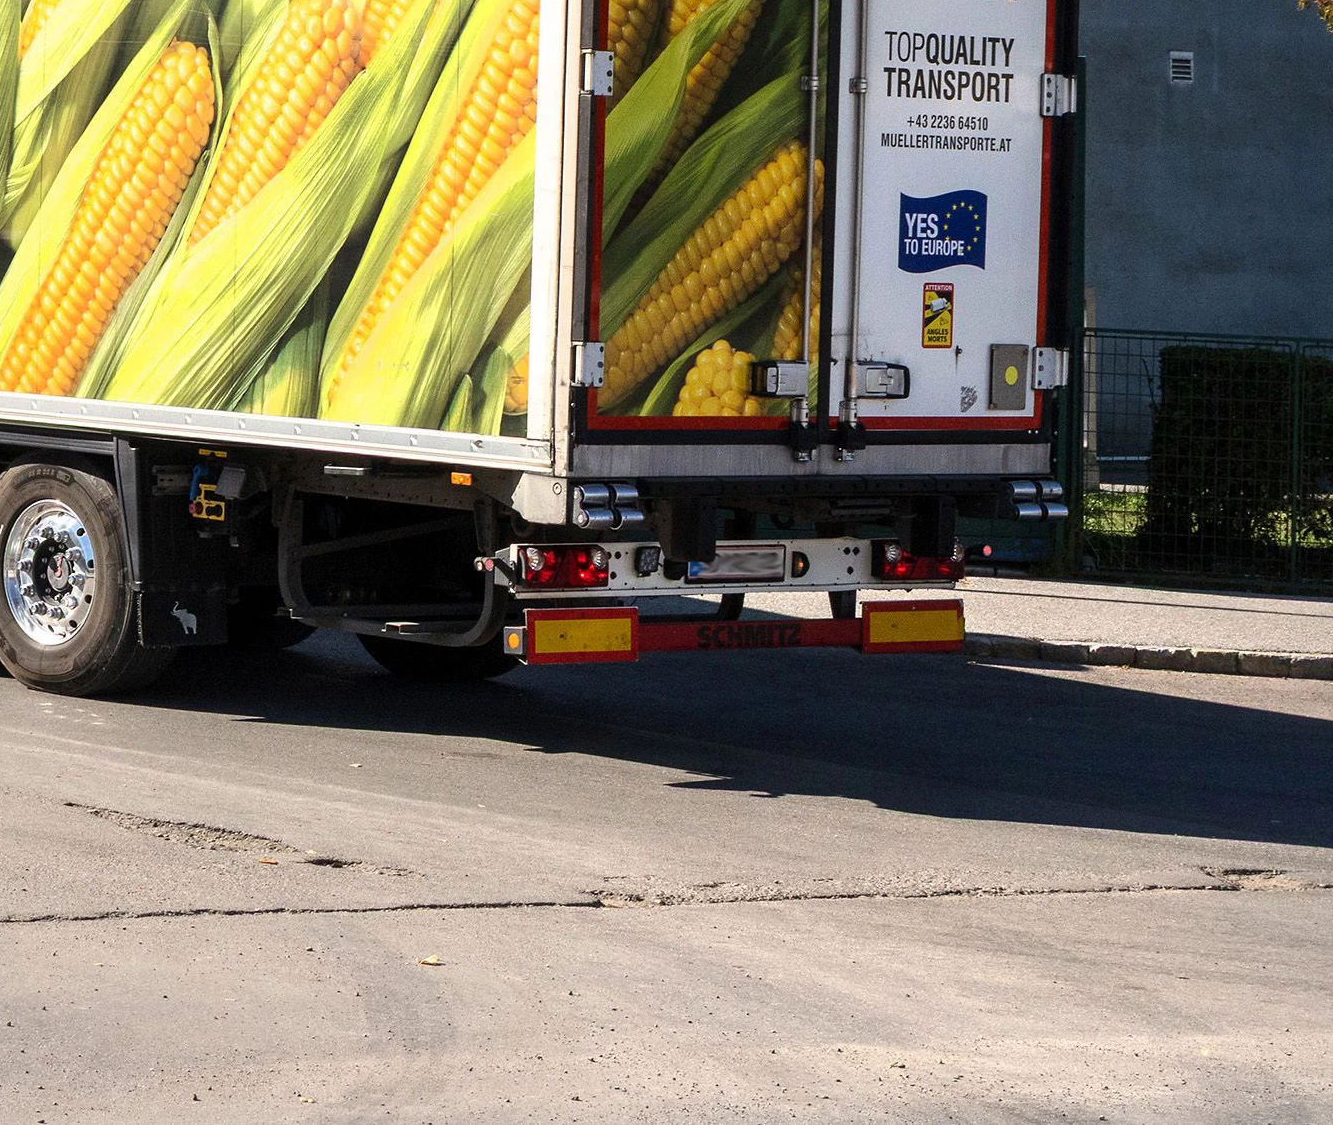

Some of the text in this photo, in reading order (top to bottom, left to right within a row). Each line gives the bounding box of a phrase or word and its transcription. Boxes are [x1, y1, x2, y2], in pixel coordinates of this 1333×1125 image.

[883, 67, 1014, 103] TRANSPORT
[907, 115, 989, 131] +43 2236 64510
[880, 133, 1012, 152] MUELLERTRANSPORTE.AT
[904, 213, 939, 239] YES
[904, 239, 965, 257] TO EUROPE
[925, 284, 953, 292] ATTENTION
[926, 328, 949, 336] ANGLES
[927, 335, 948, 343] MORTS
[696, 624, 802, 650] SCHMITZ
